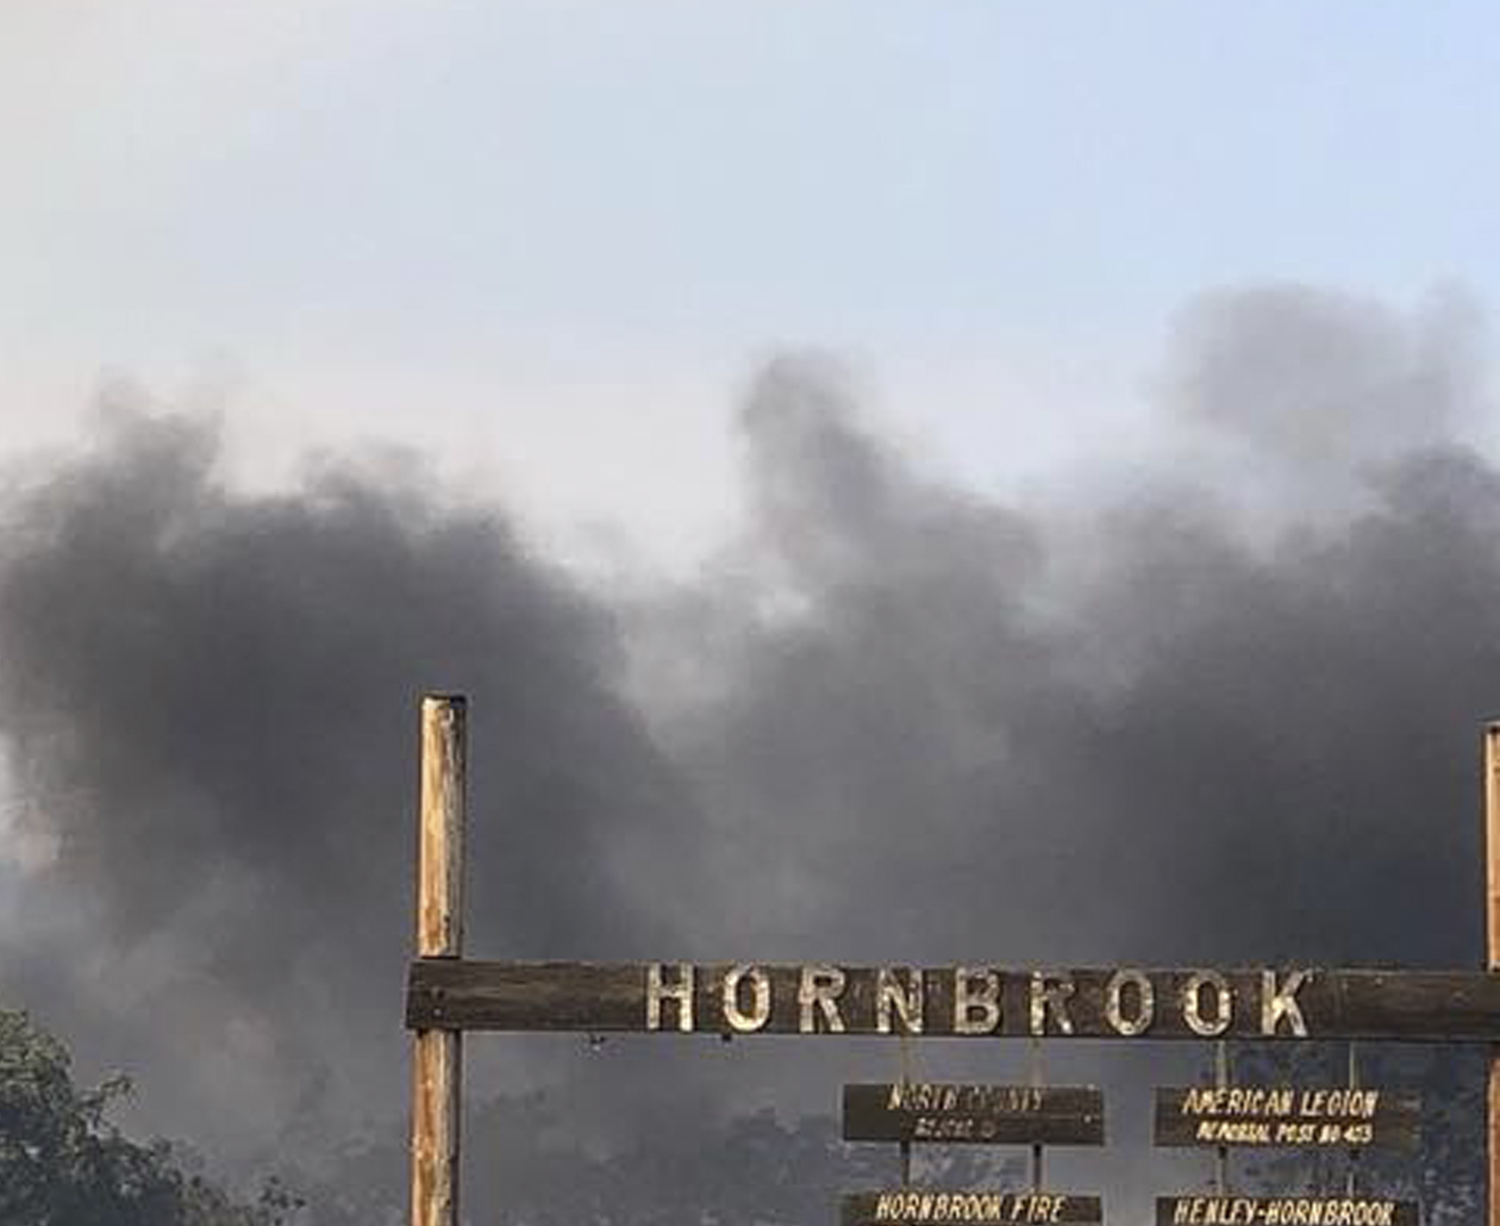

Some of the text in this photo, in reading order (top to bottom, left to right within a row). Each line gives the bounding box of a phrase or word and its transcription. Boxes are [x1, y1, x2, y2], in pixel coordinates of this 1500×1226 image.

[646, 961, 1312, 1037] HORNBROOK
[1182, 1088, 1380, 1118] AMERICAN LEGION
[876, 1193, 1067, 1223] HORNBROOK FIRE
